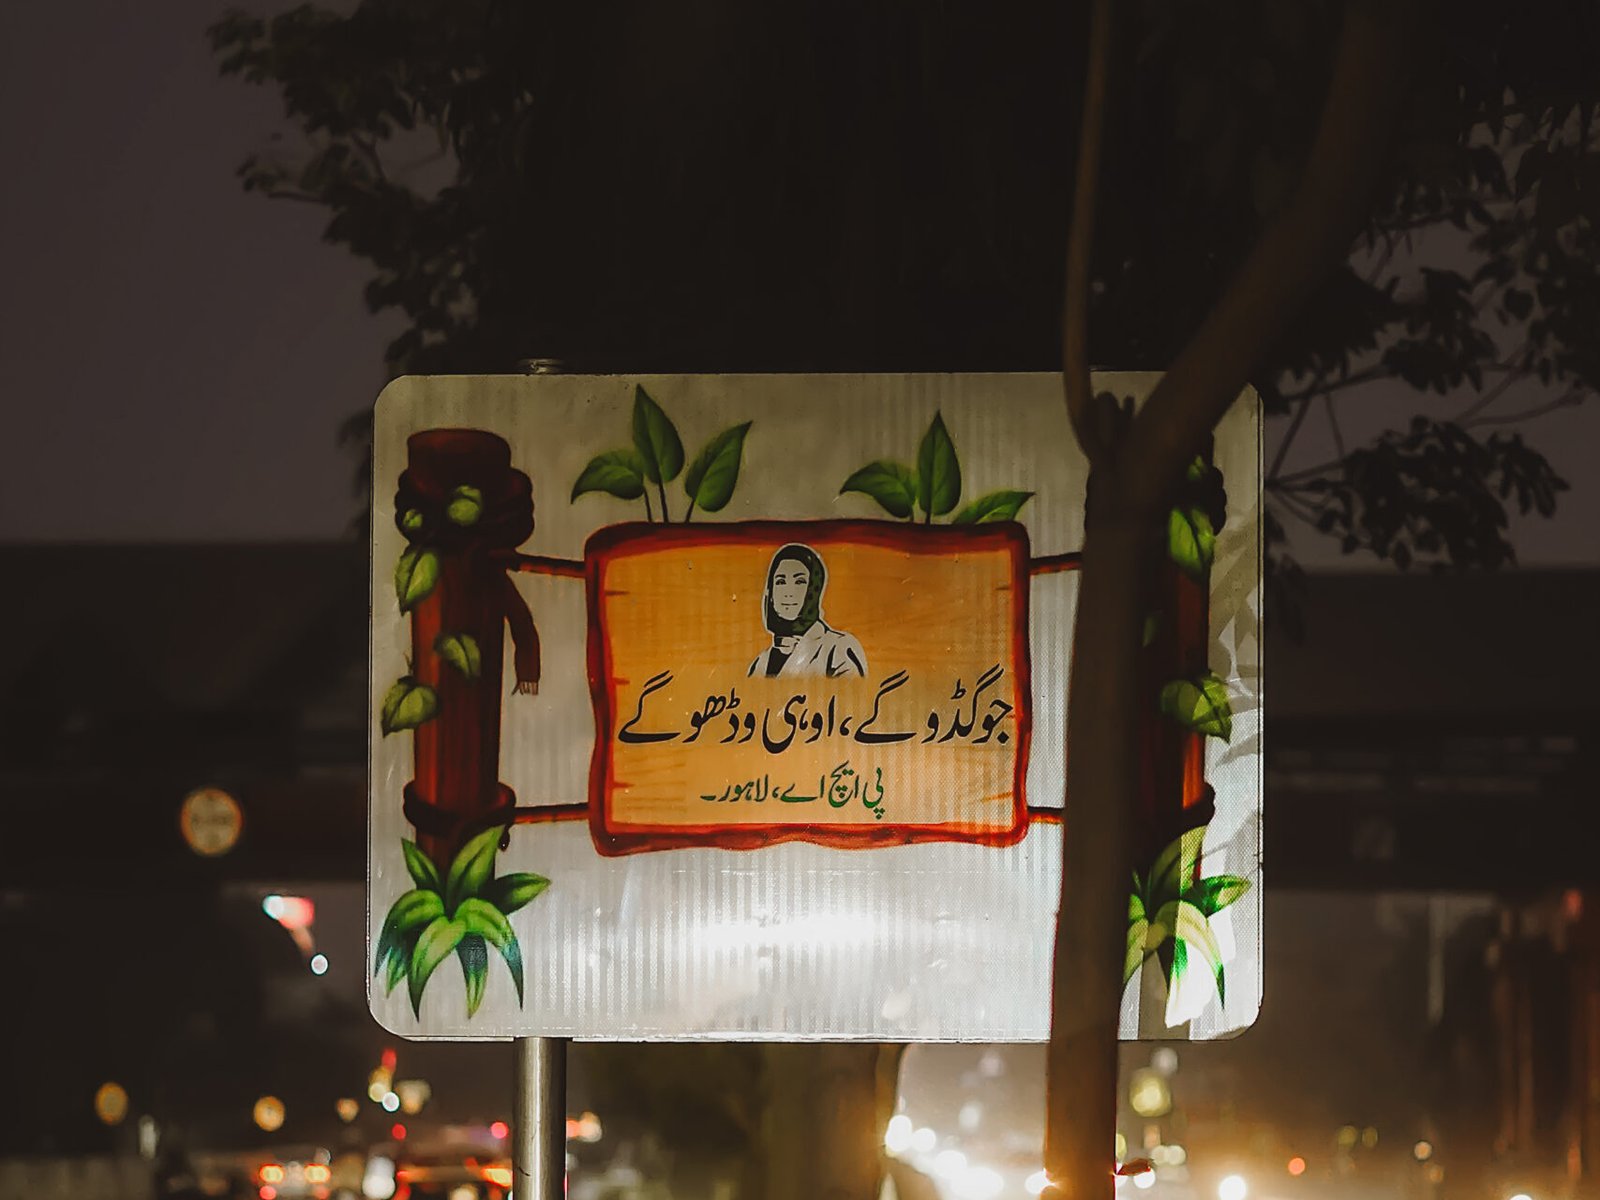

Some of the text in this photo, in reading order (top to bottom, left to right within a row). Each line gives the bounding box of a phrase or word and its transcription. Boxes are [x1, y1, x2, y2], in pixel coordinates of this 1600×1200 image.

[618, 670, 681, 744] گے
[828, 760, 860, 808] ایچ
[862, 767, 886, 820] پی
